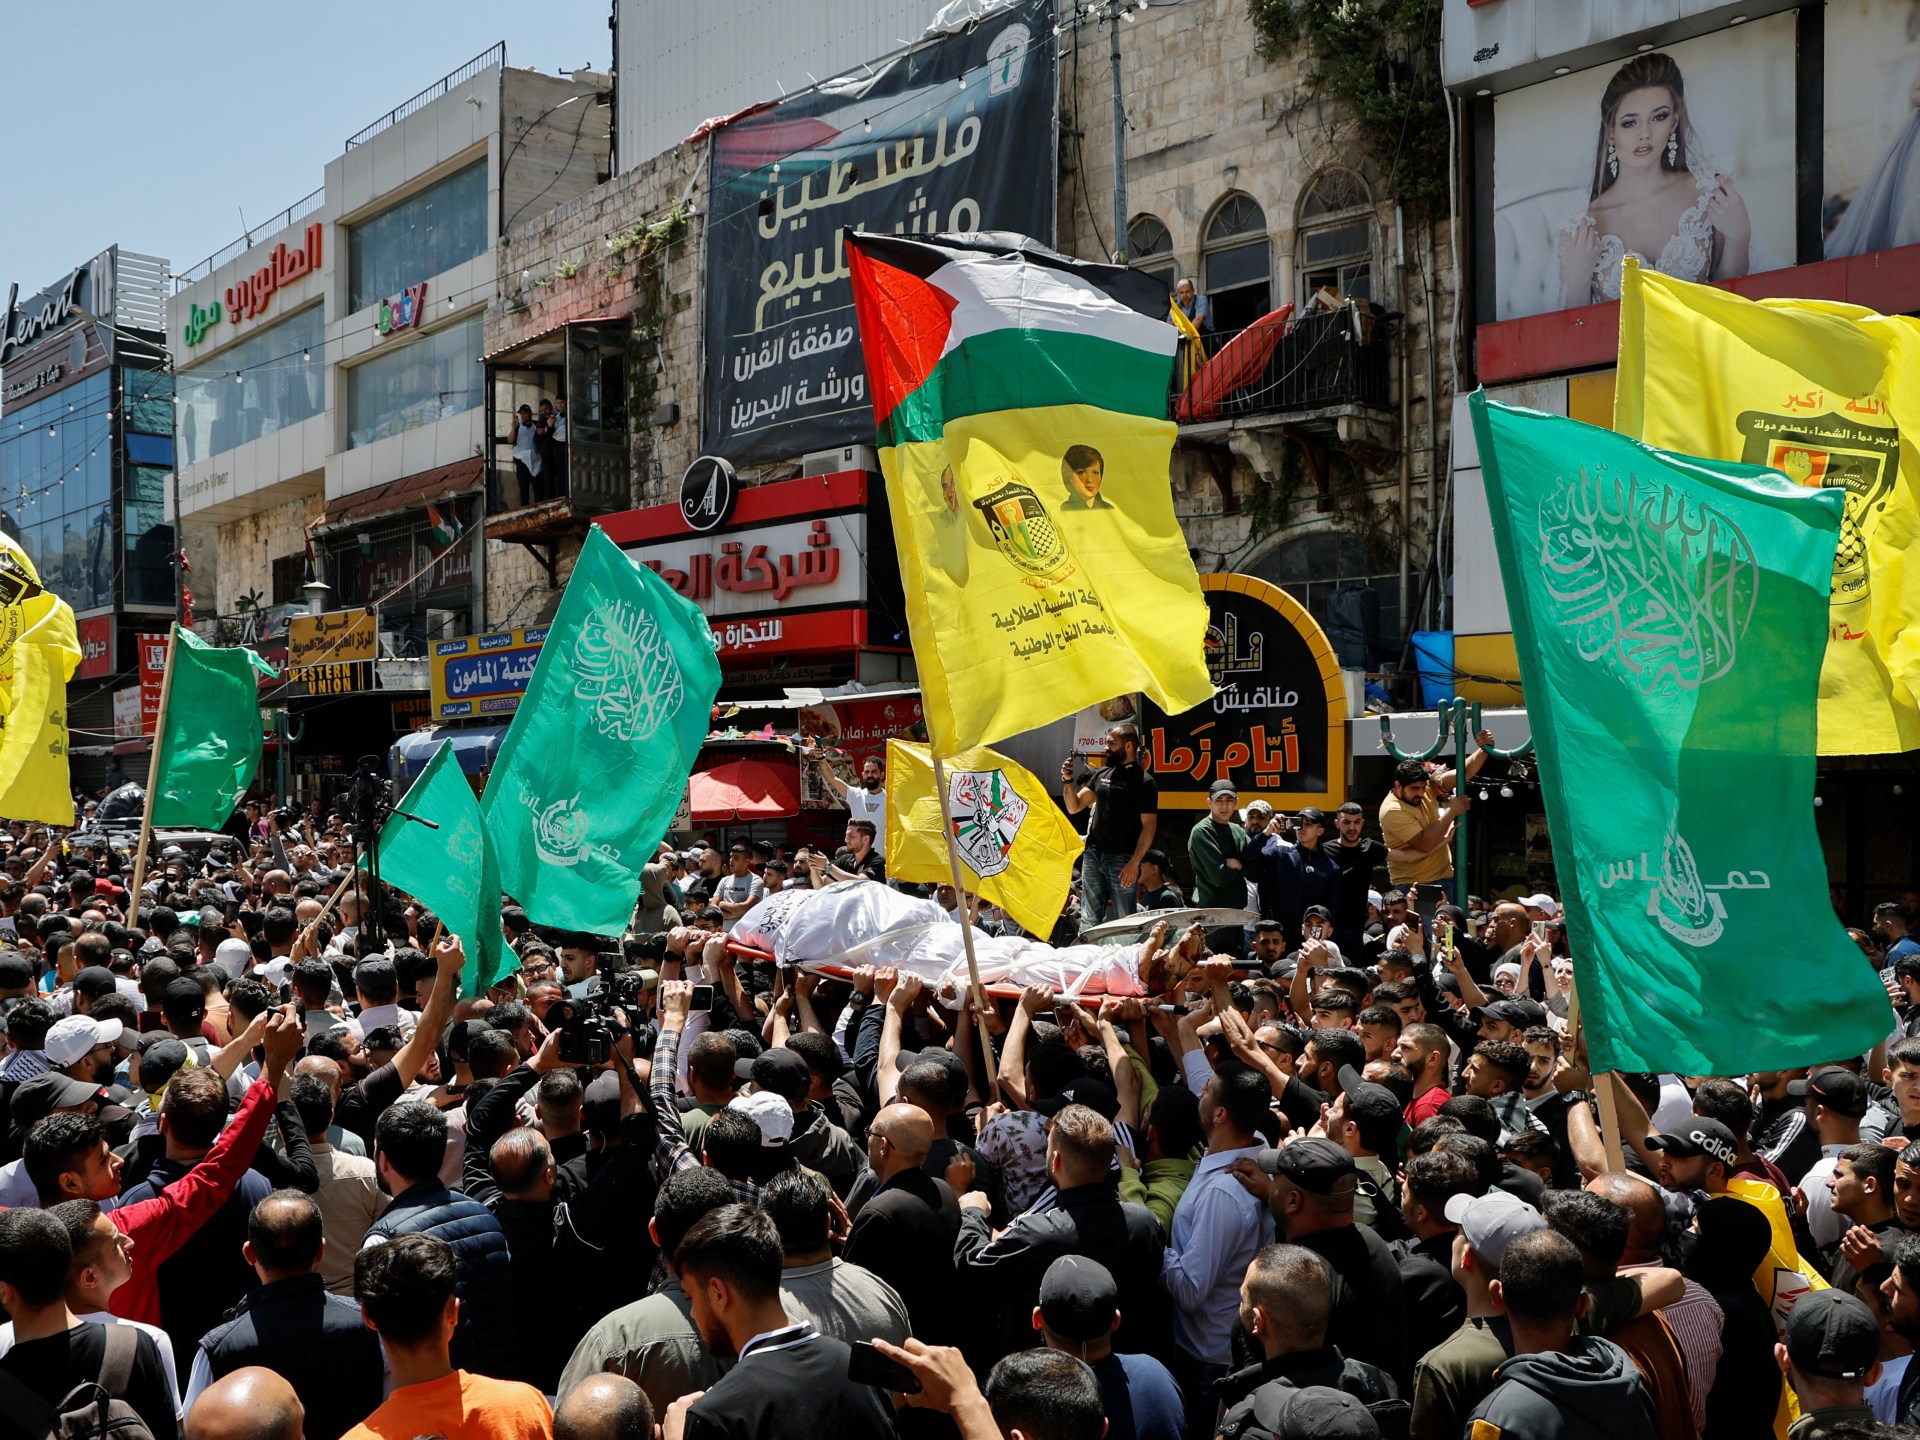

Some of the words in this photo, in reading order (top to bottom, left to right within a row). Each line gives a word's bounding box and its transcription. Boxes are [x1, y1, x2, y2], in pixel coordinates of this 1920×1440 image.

[758, 100, 982, 239] فلسطين
[755, 221, 865, 332] لبيع
[0, 267, 81, 362] Levant
[183, 300, 221, 346] مول
[378, 282, 428, 335] baby
[734, 336, 785, 382] القرن
[789, 323, 854, 362] صفقة
[795, 367, 865, 408] ورشة
[1780, 390, 1824, 413] أكبر
[731, 385, 792, 430] البحرين
[1753, 419, 1777, 432] دولة
[715, 519, 839, 601] شركة
[725, 620, 783, 649] للتجارة
[992, 601, 1044, 633] الطلابية
[1010, 631, 1056, 661] الوطنية
[289, 663, 351, 682] WESTERN
[308, 678, 351, 694] UNION
[452, 659, 498, 693] المأمون
[502, 653, 537, 687] كتبة
[1213, 684, 1299, 714] مناقيش
